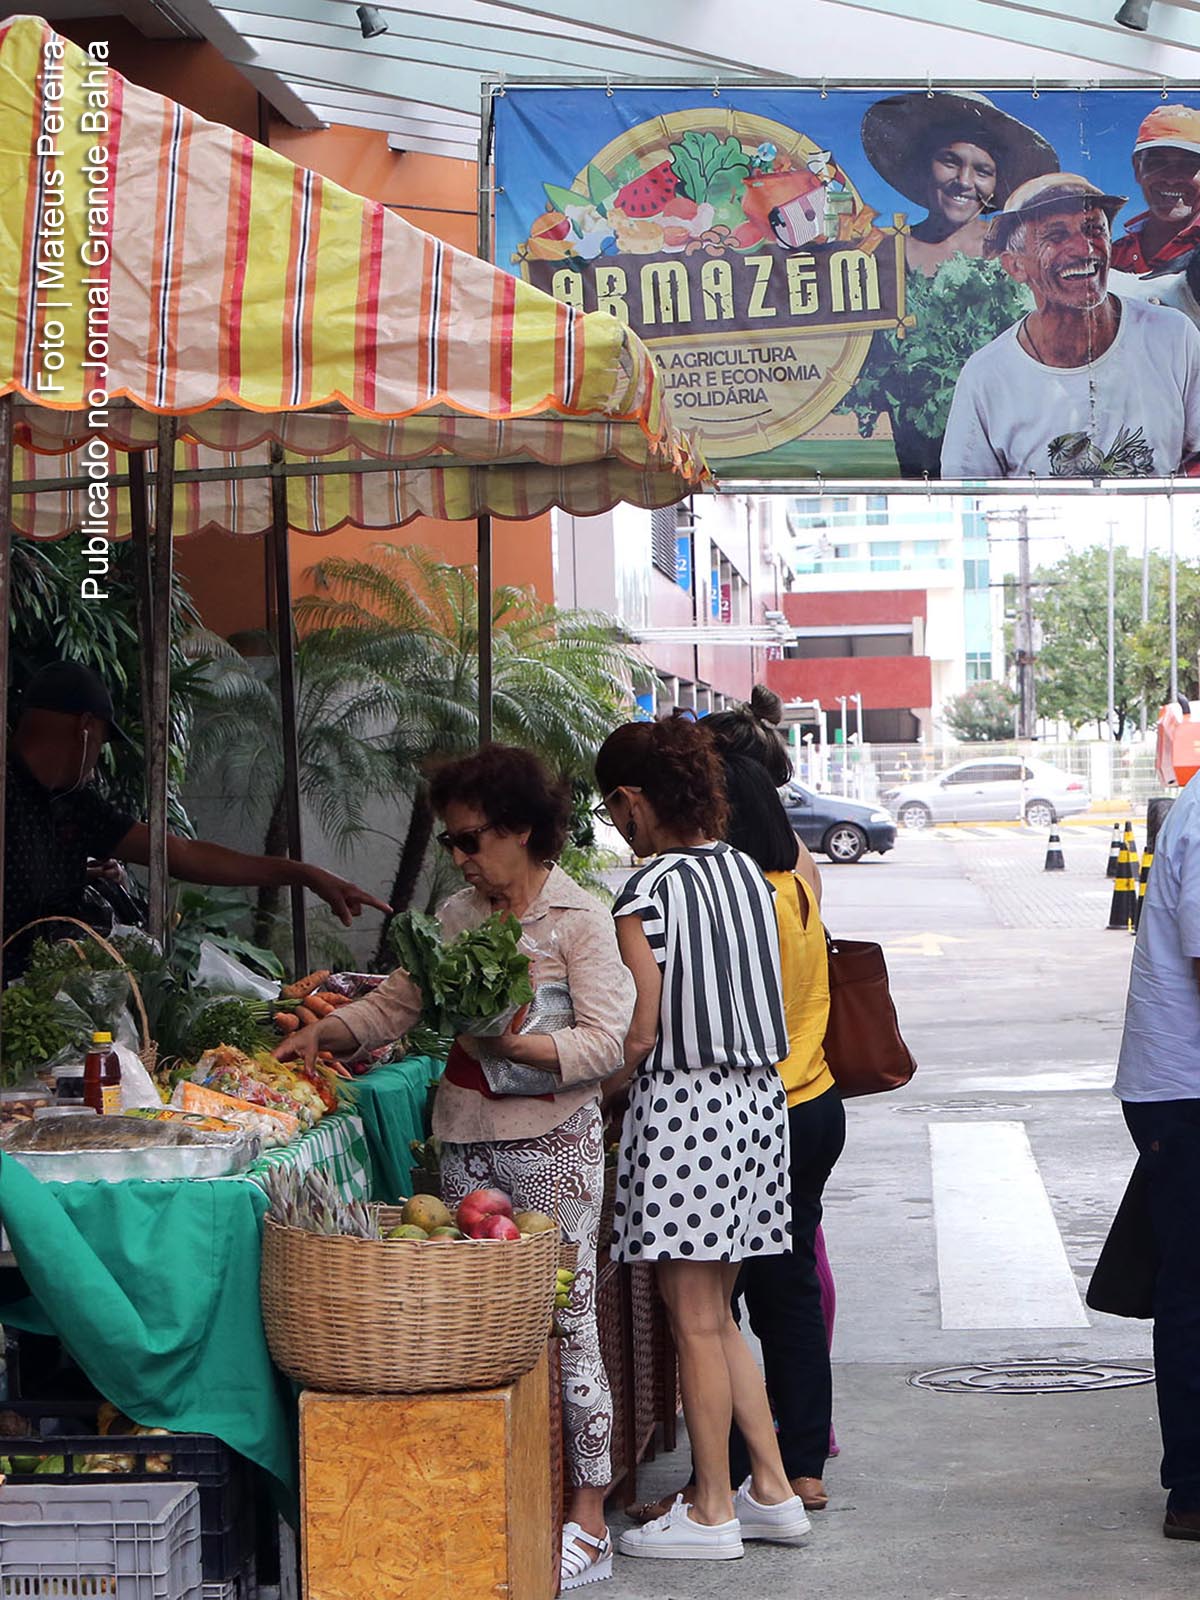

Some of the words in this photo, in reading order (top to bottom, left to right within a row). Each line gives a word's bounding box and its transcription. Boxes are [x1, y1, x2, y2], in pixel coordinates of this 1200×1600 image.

[670, 345, 797, 369] AGRICULTURA
[662, 371, 702, 389] LIAR
[706, 370, 717, 387] E
[721, 363, 822, 385] ECONOMIA
[673, 386, 769, 409] SOLIDÁRIA
